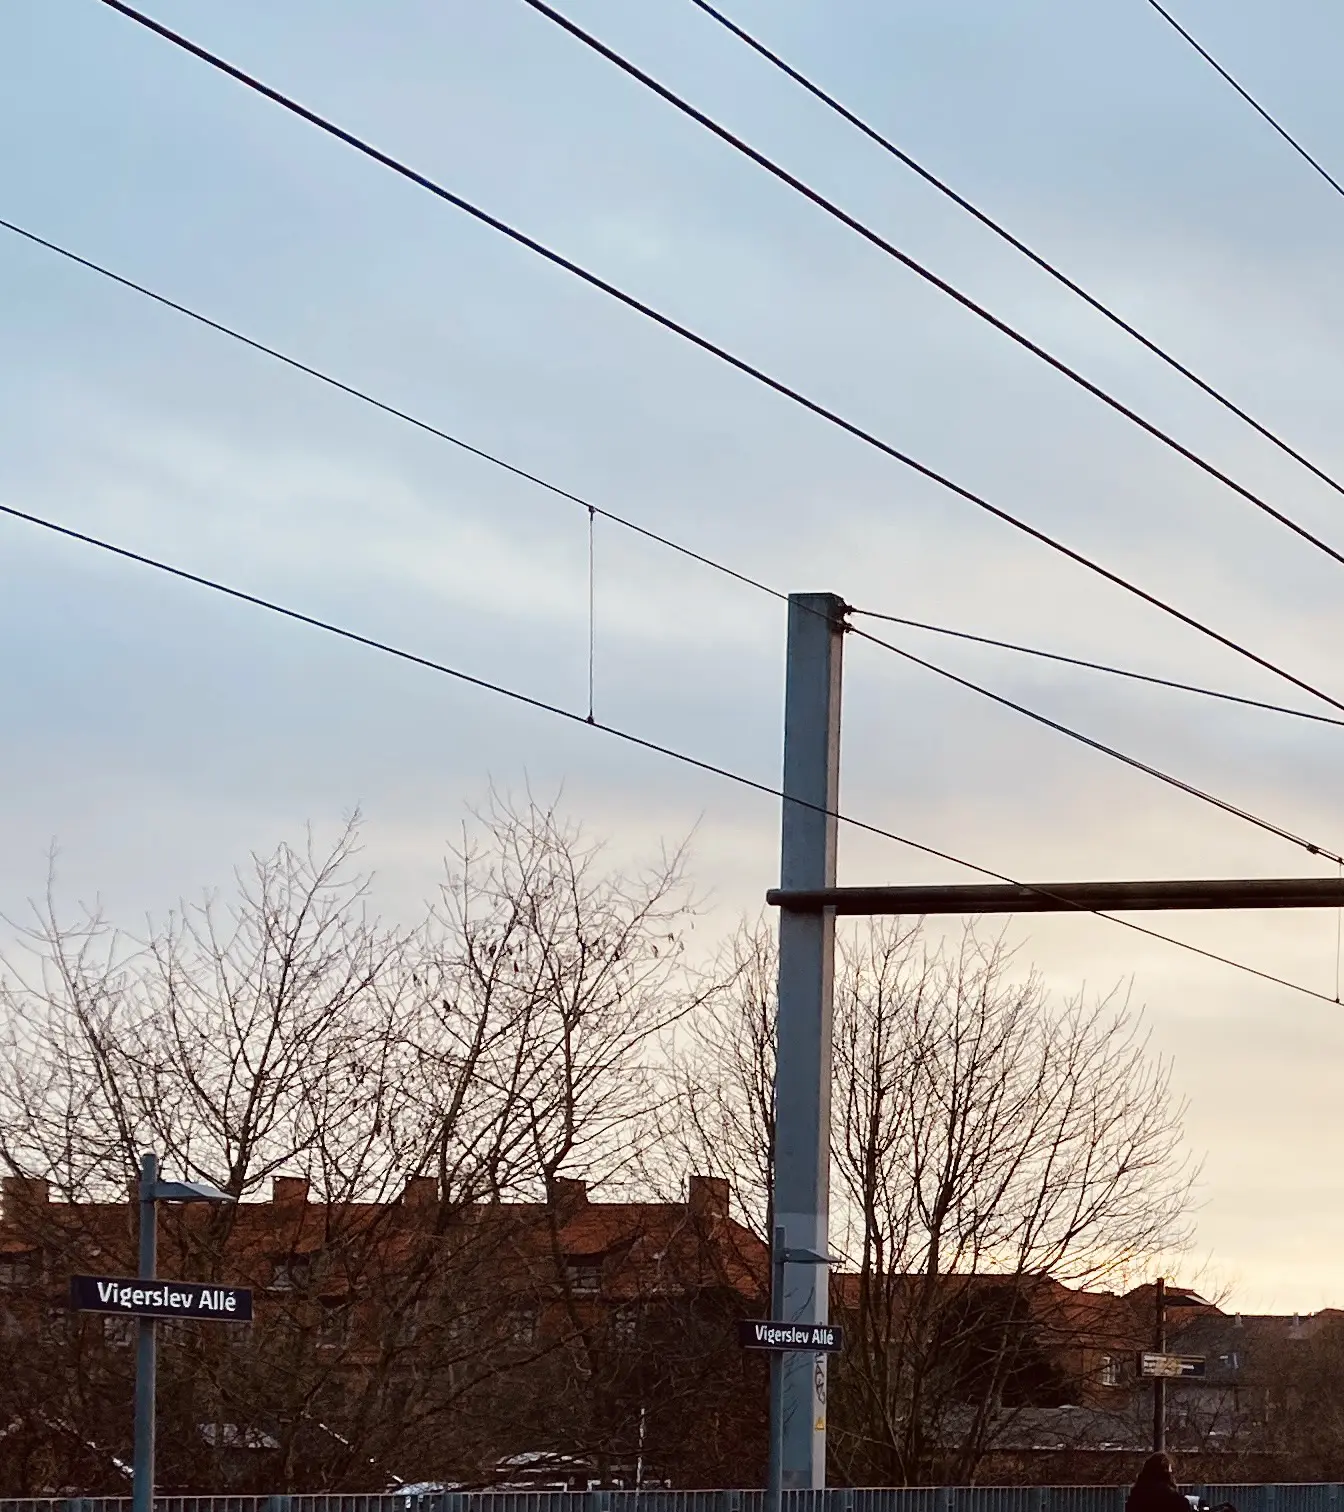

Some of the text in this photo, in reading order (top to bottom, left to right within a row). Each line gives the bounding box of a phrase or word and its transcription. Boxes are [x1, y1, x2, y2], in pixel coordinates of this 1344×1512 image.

[97, 1281, 237, 1312] Vigerslev Allé
[755, 1324, 834, 1346] Vigerslev Allé
